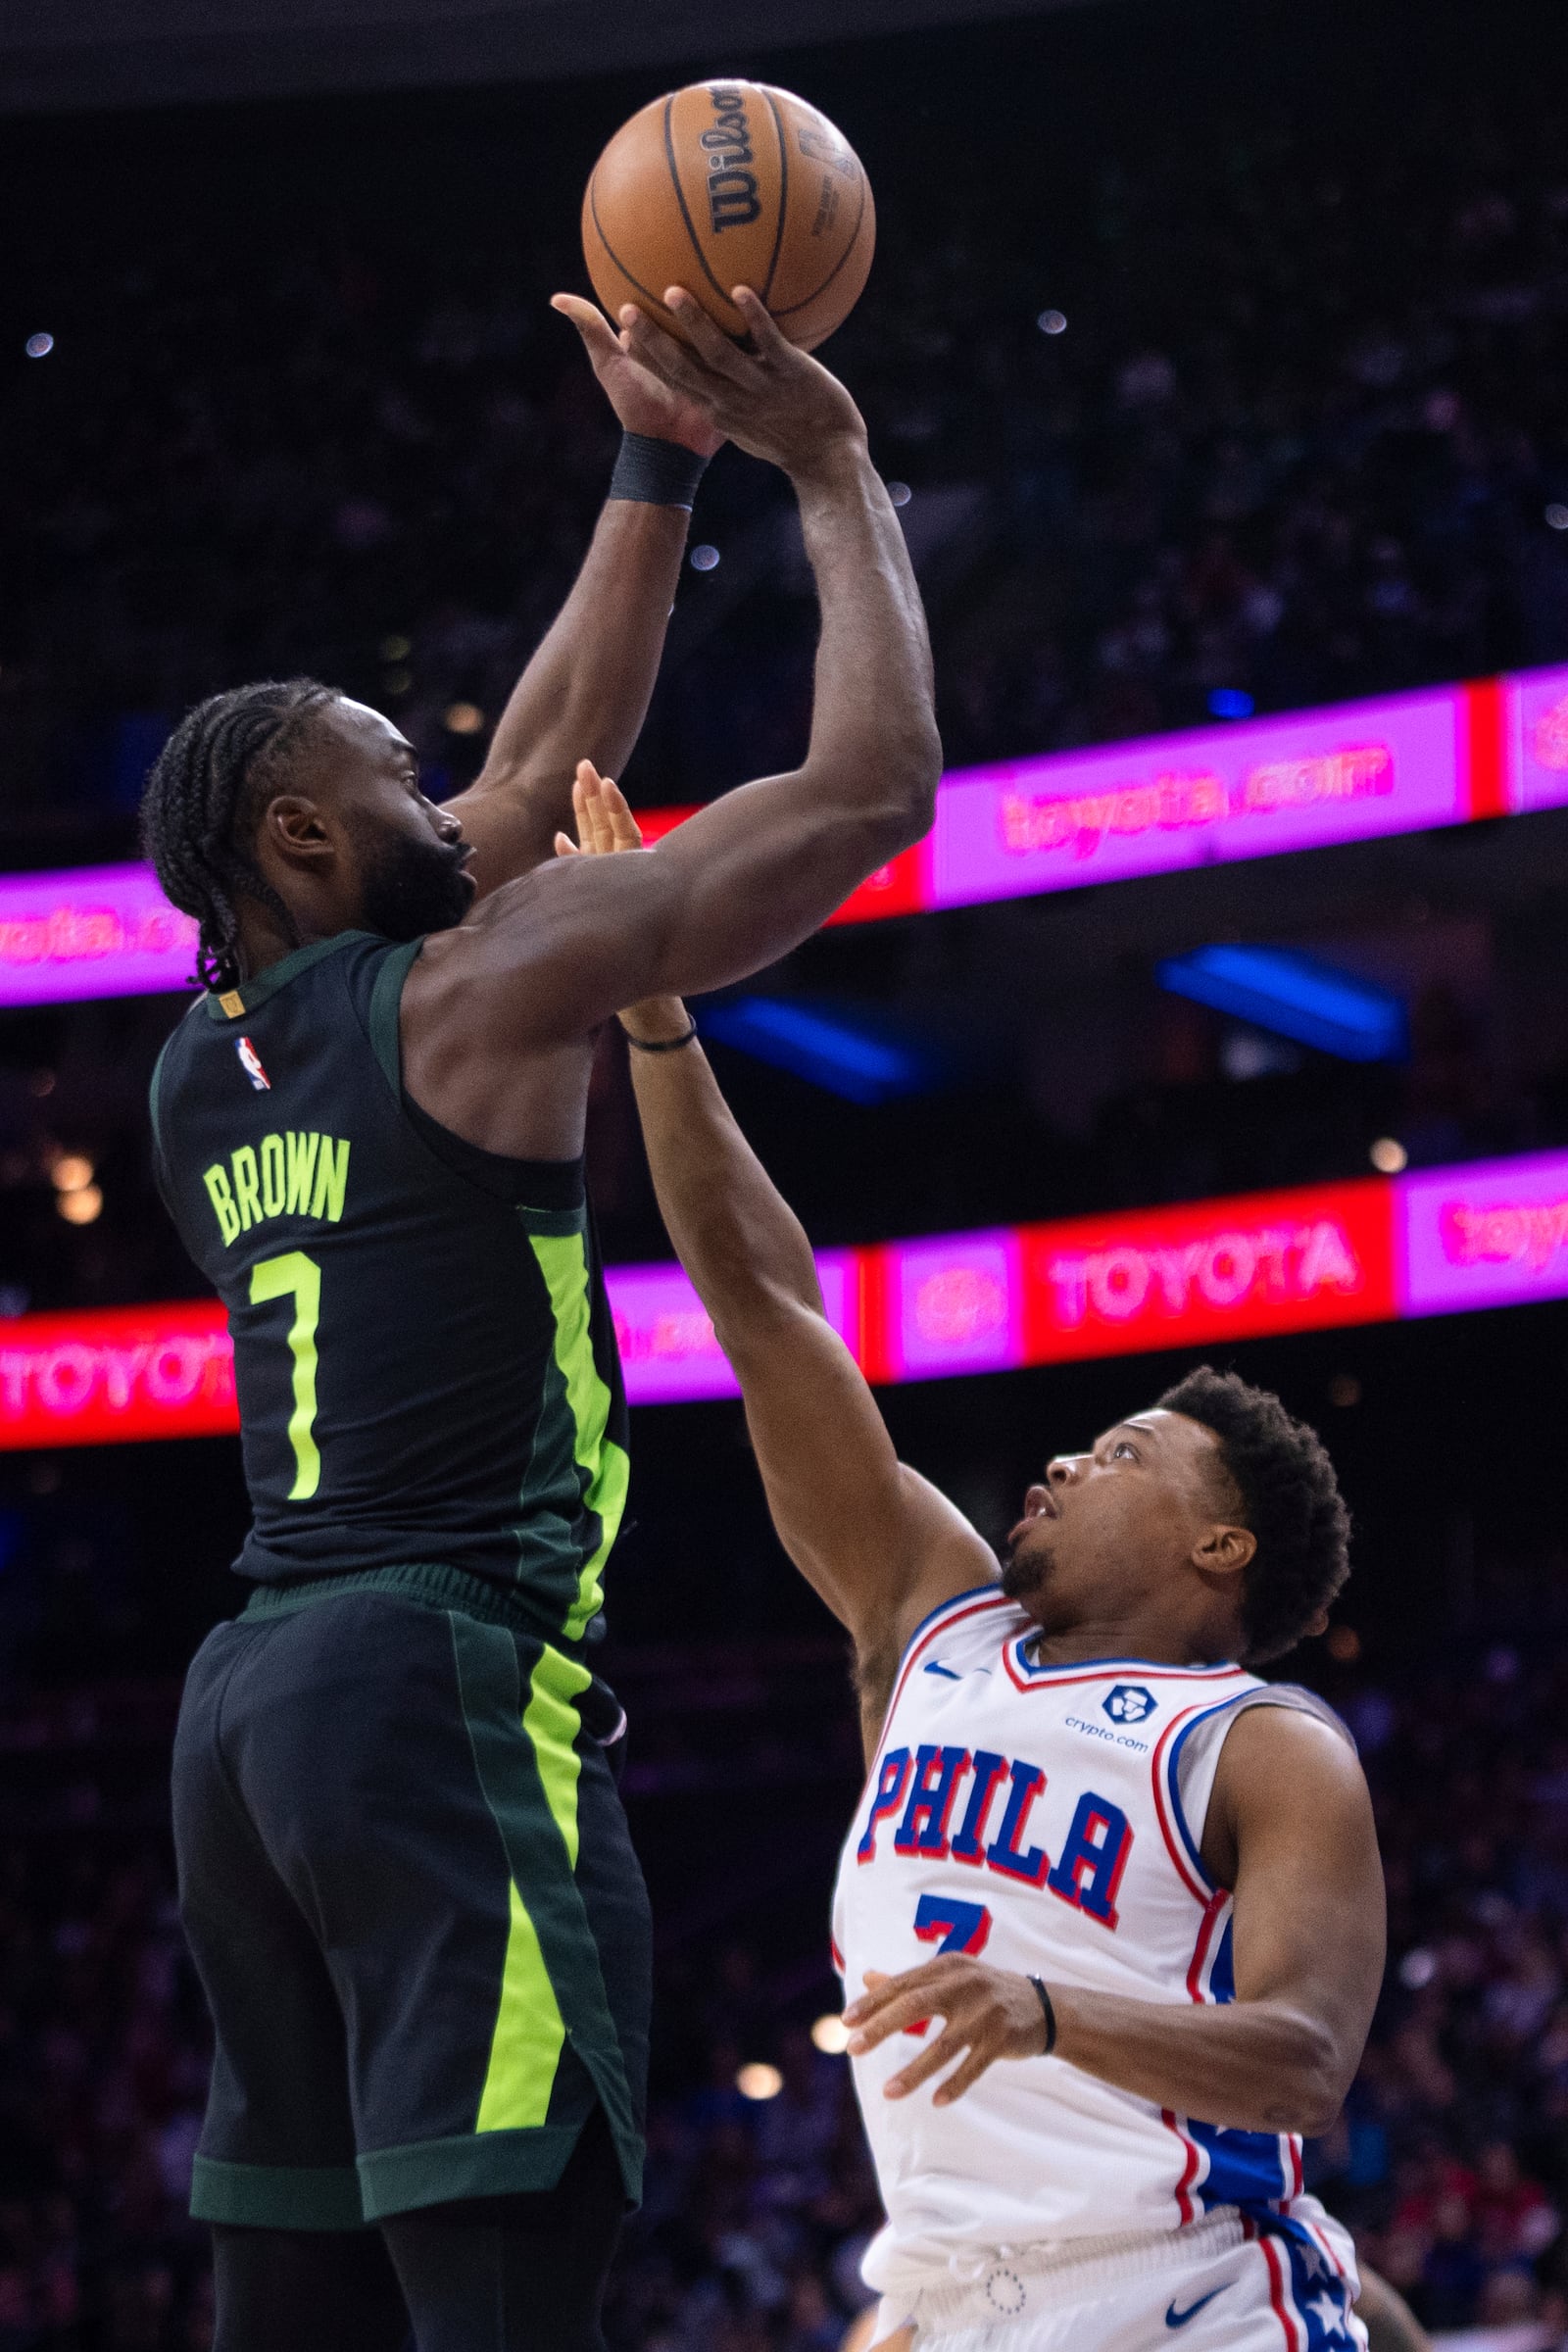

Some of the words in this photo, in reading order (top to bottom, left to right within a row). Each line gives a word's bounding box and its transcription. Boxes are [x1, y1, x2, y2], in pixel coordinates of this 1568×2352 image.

[202, 1130, 352, 1250] BROWN
[1047, 1221, 1359, 1330] TOYOTA
[249, 1250, 322, 1501] 7
[1064, 1716, 1150, 1754] crypto.com
[857, 1743, 1135, 1934] PHILA
